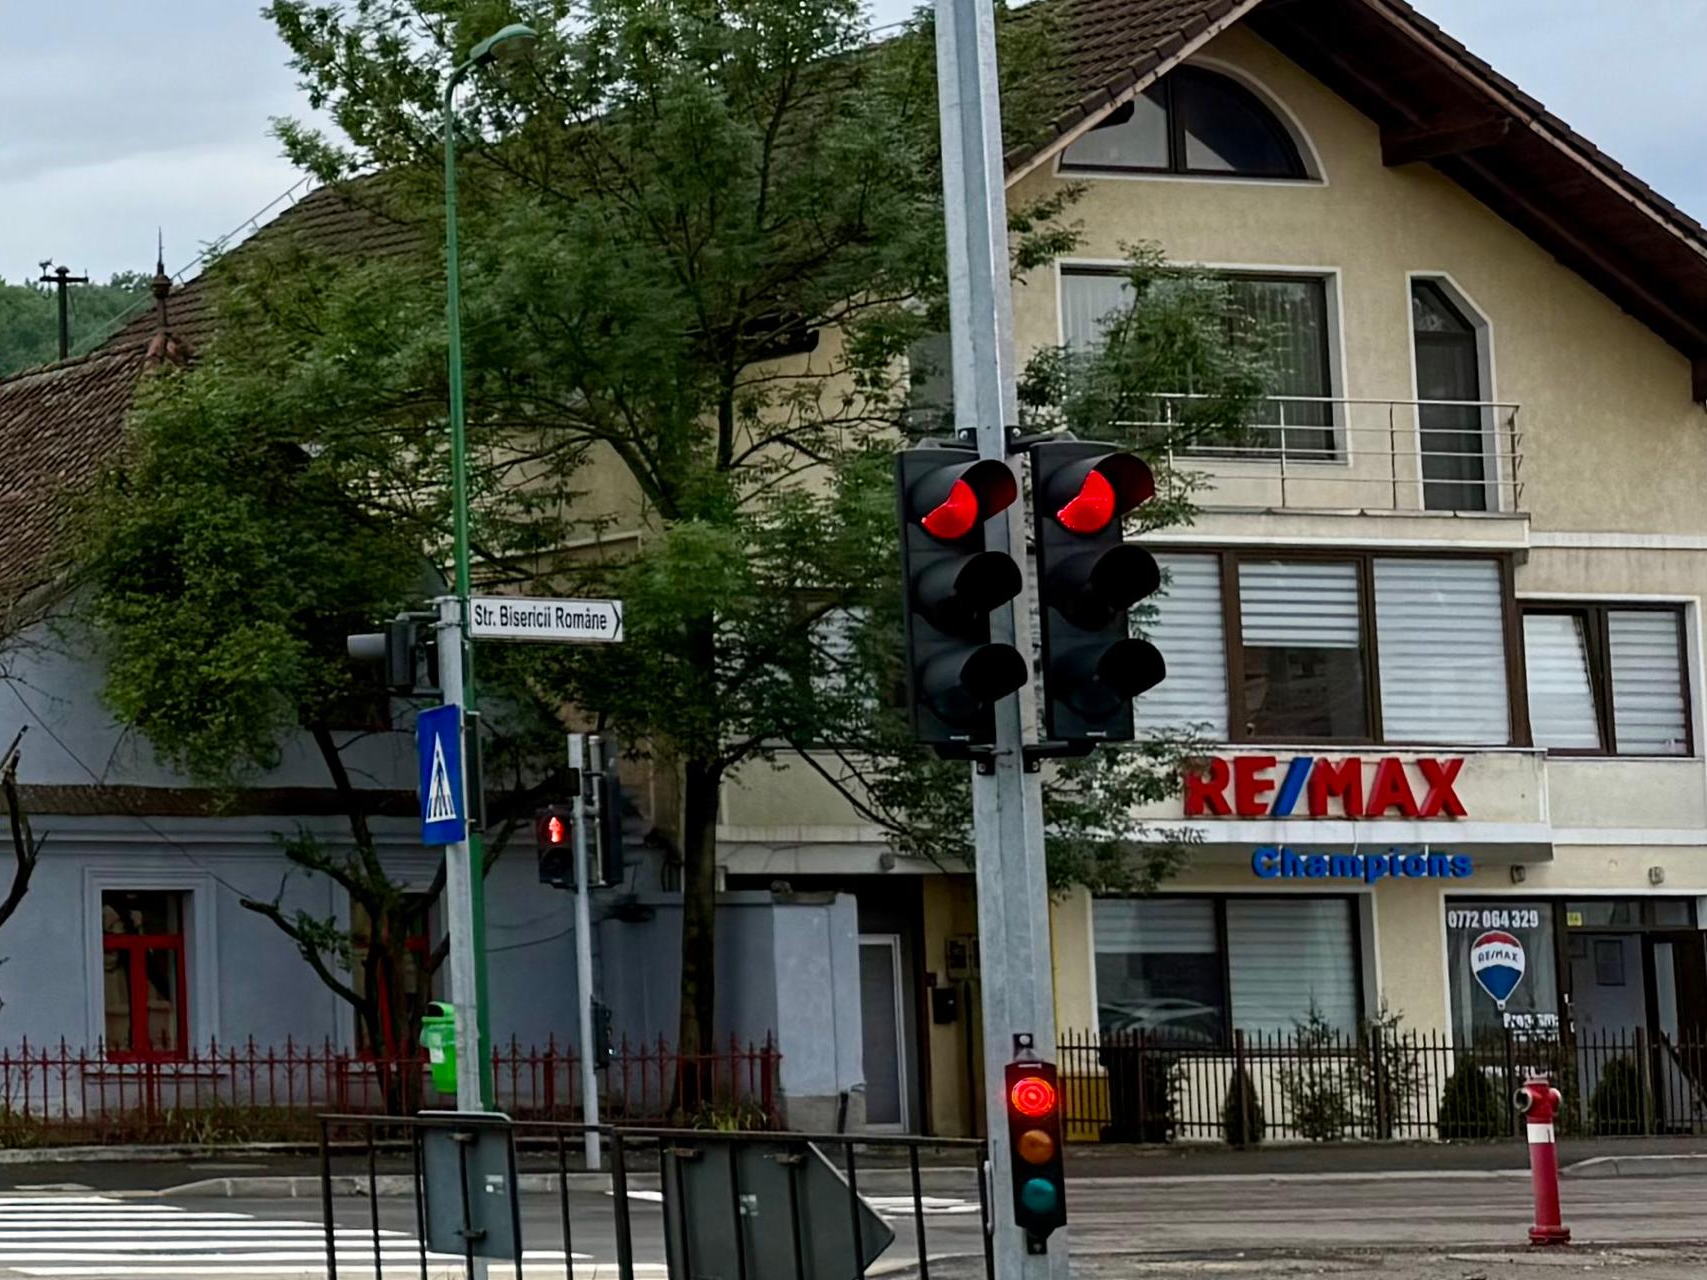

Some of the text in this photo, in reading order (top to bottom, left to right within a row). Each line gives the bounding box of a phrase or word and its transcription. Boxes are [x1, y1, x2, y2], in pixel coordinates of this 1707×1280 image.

[475, 604, 607, 629] Str. Bisericii Române
[1183, 756, 1467, 817] RE/MAX
[1252, 846, 1473, 883] Champions
[1448, 910, 1479, 928] 0772
